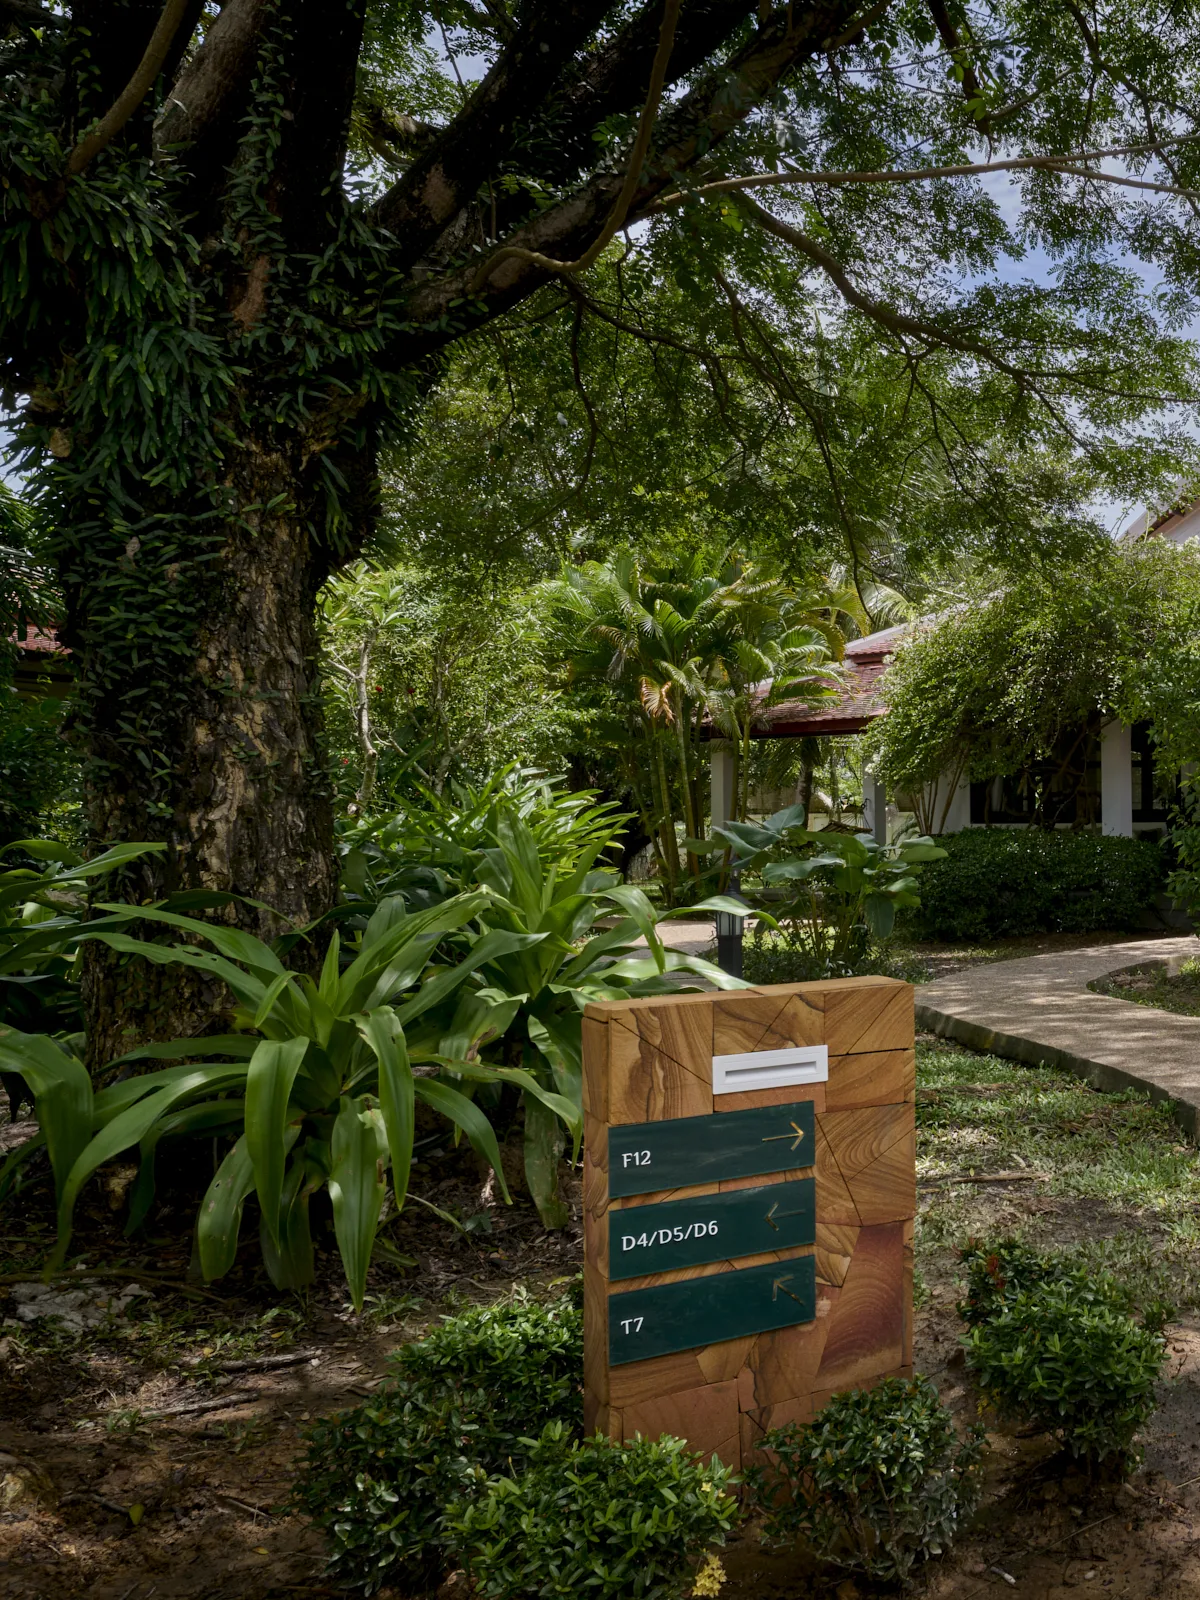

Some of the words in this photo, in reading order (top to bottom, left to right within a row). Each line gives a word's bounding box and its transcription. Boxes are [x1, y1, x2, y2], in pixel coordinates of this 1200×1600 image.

[621, 1150, 652, 1168] F12
[621, 1220, 719, 1251] D4/D5/D6
[620, 1316, 644, 1335] T7
